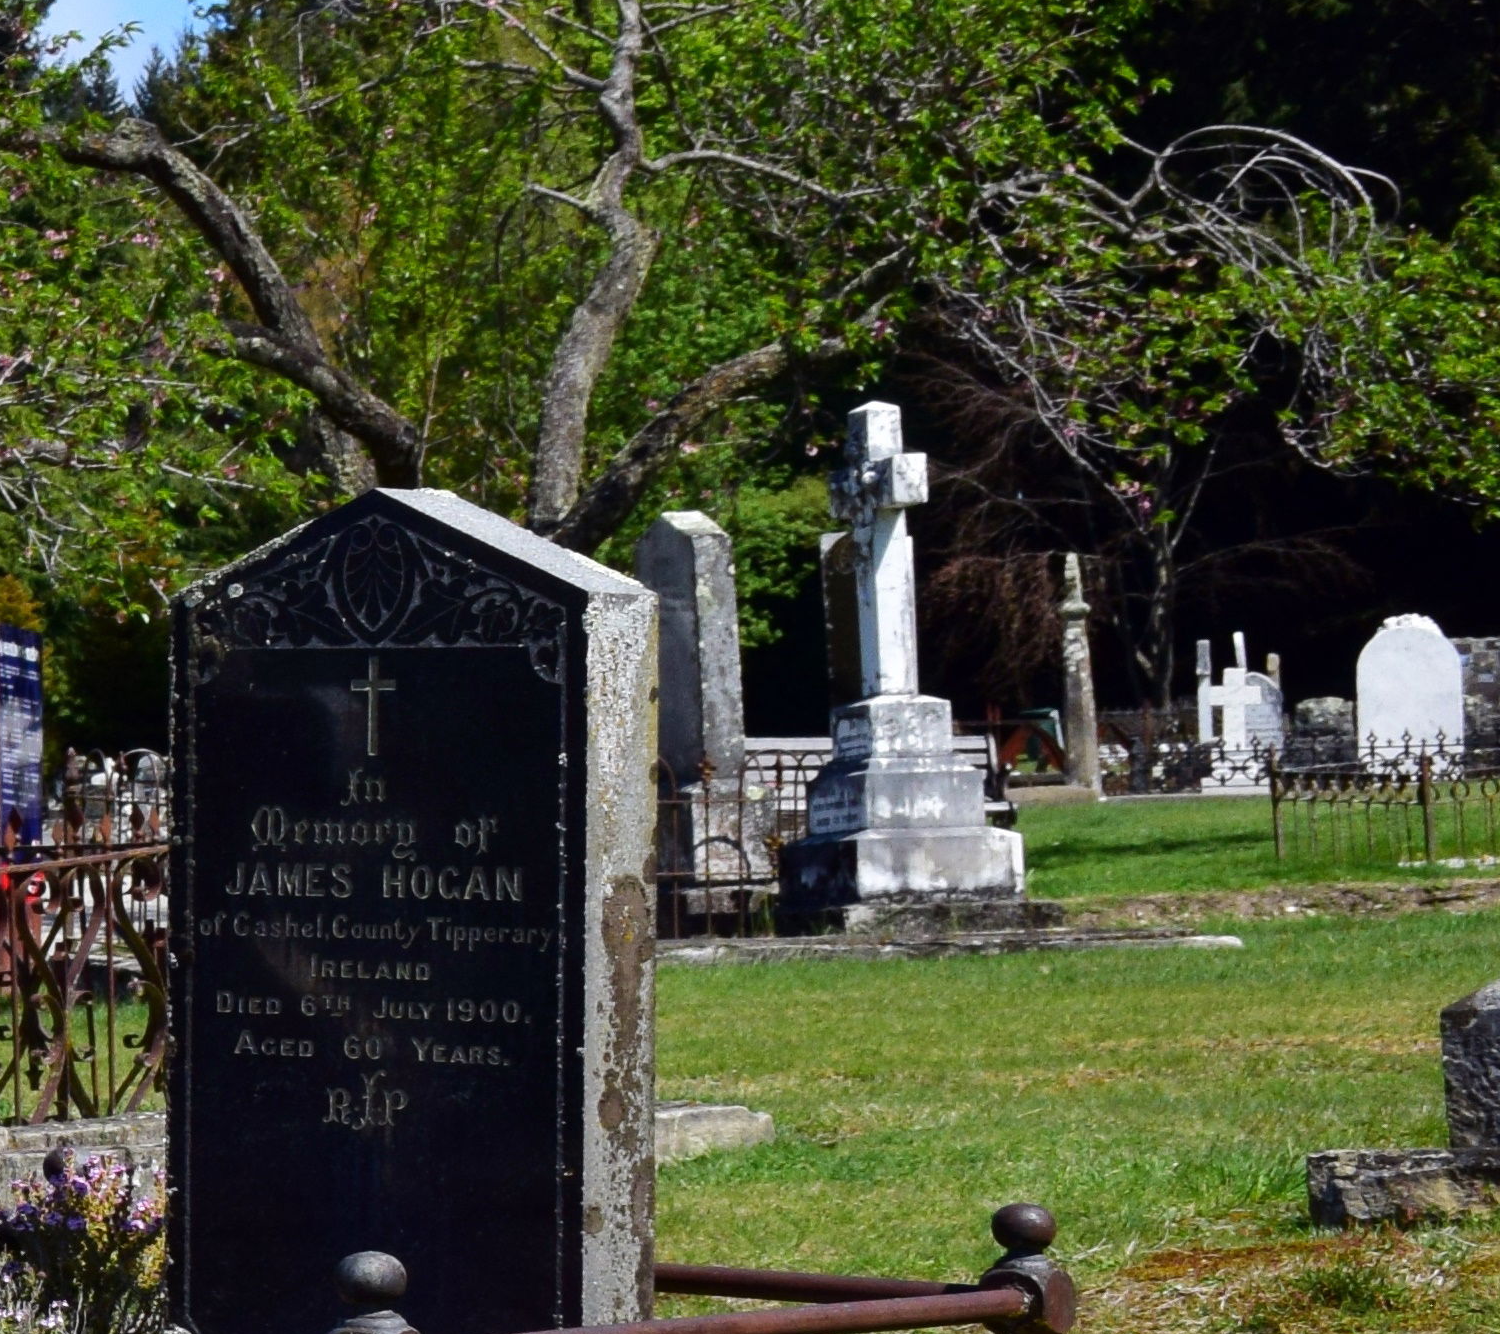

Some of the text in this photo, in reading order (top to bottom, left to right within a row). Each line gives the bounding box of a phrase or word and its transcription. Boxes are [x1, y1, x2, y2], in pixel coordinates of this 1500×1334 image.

[251, 805, 499, 862] Memory of
[225, 861, 524, 903] JAMES HOGAN
[200, 910, 553, 953] of Cashel, County Tipperary
[309, 952, 432, 983] IRELAND
[215, 989, 283, 1016] DIED
[372, 996, 437, 1021] JULY
[446, 997, 534, 1026] 1900.
[232, 1028, 512, 1068] AGED 60 YEARS.
